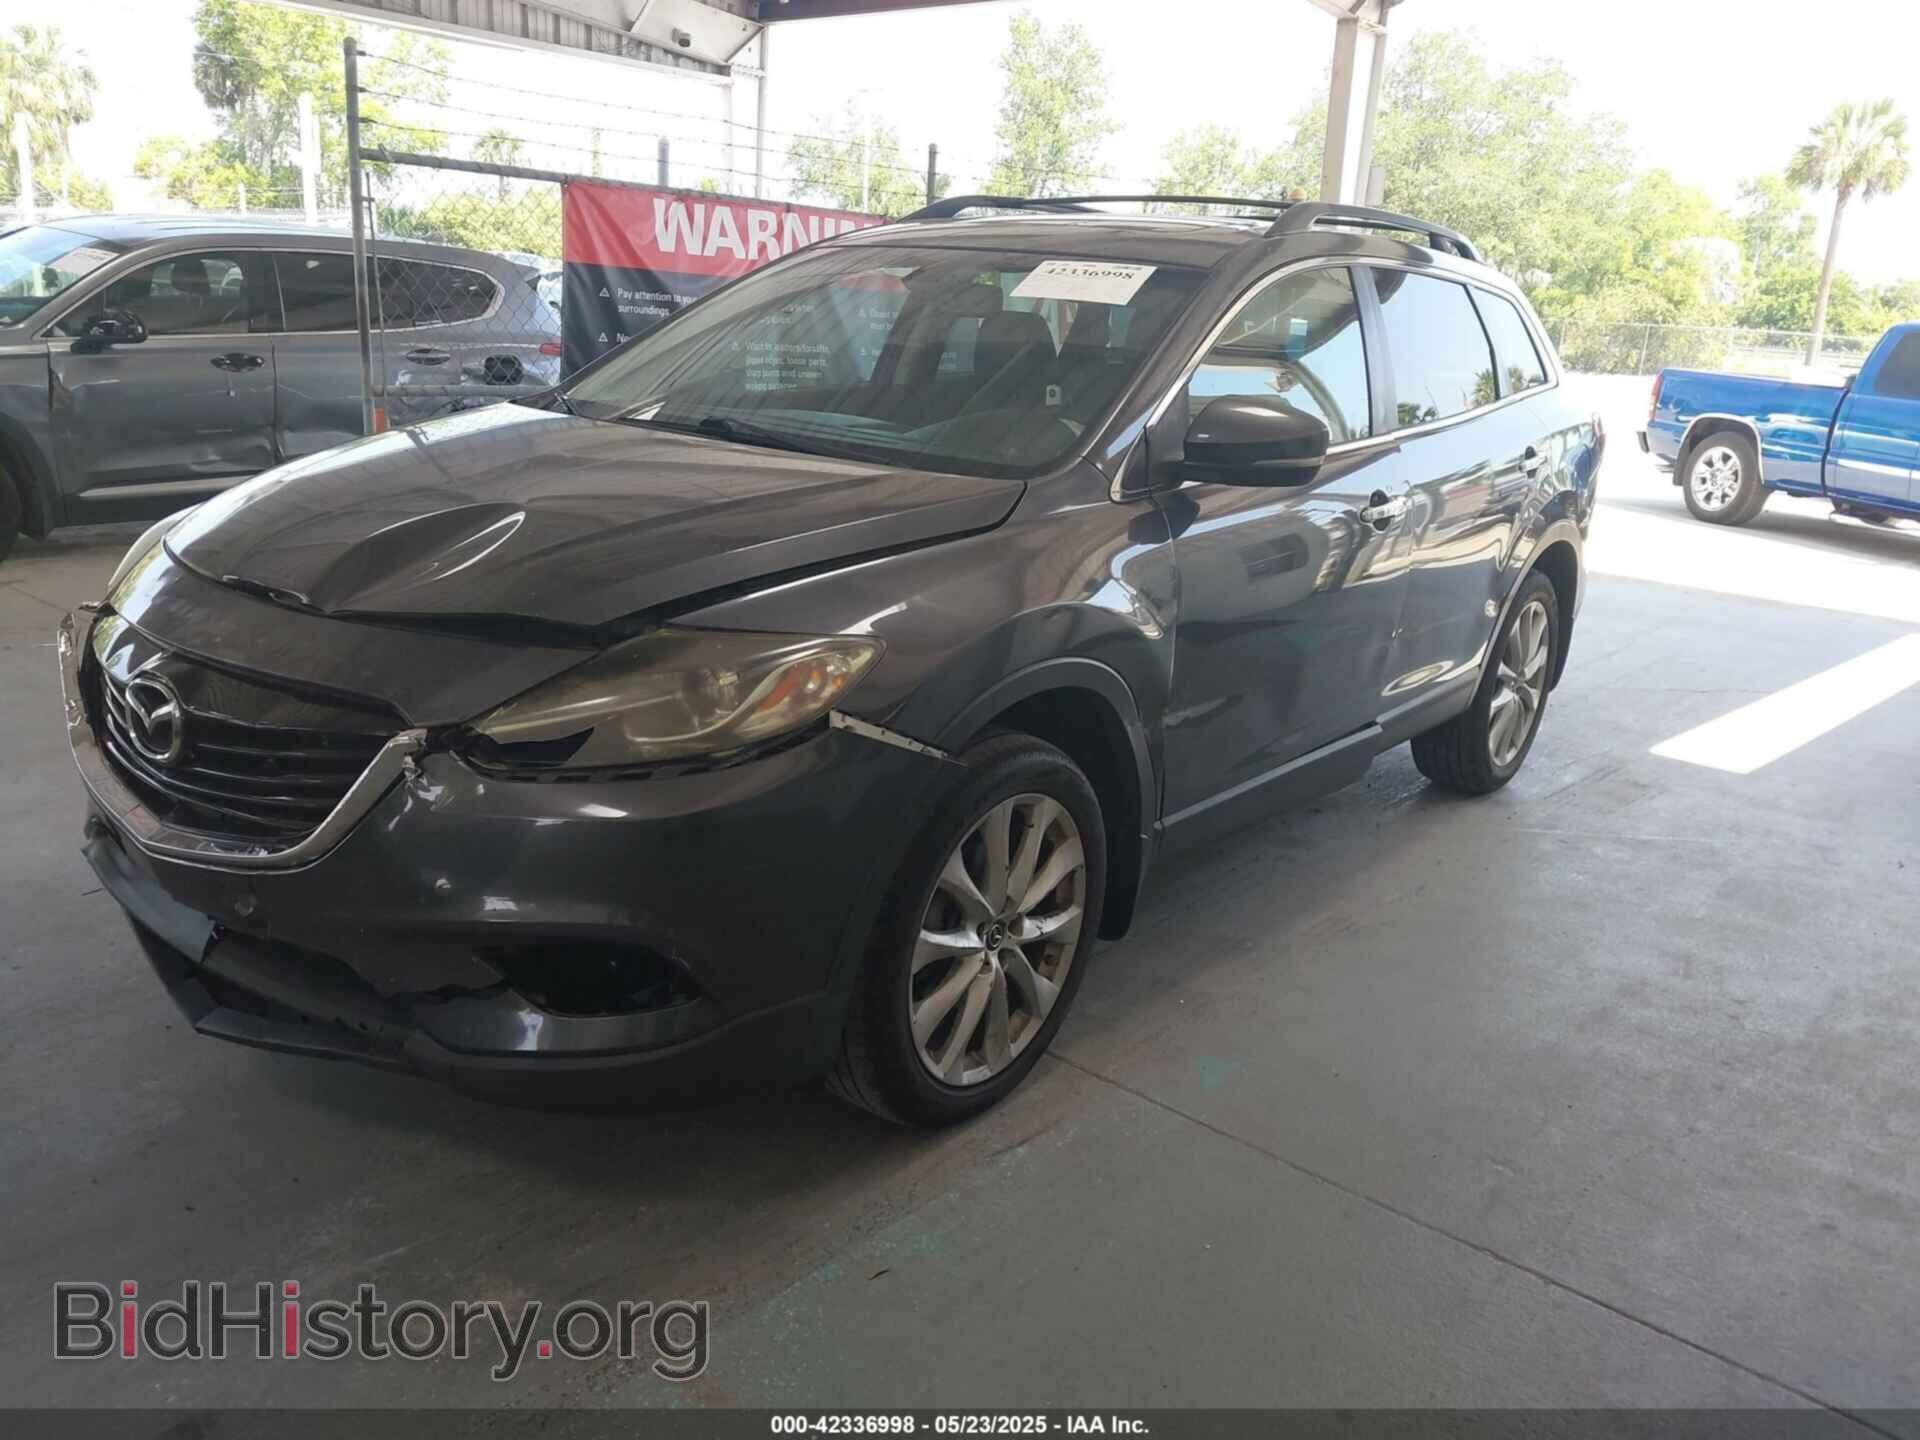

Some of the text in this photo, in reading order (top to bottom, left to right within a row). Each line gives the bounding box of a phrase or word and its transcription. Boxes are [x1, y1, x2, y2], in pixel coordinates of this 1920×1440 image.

[653, 198, 873, 261] WARN
[617, 287, 633, 300] Pay
[634, 291, 672, 302] attention
